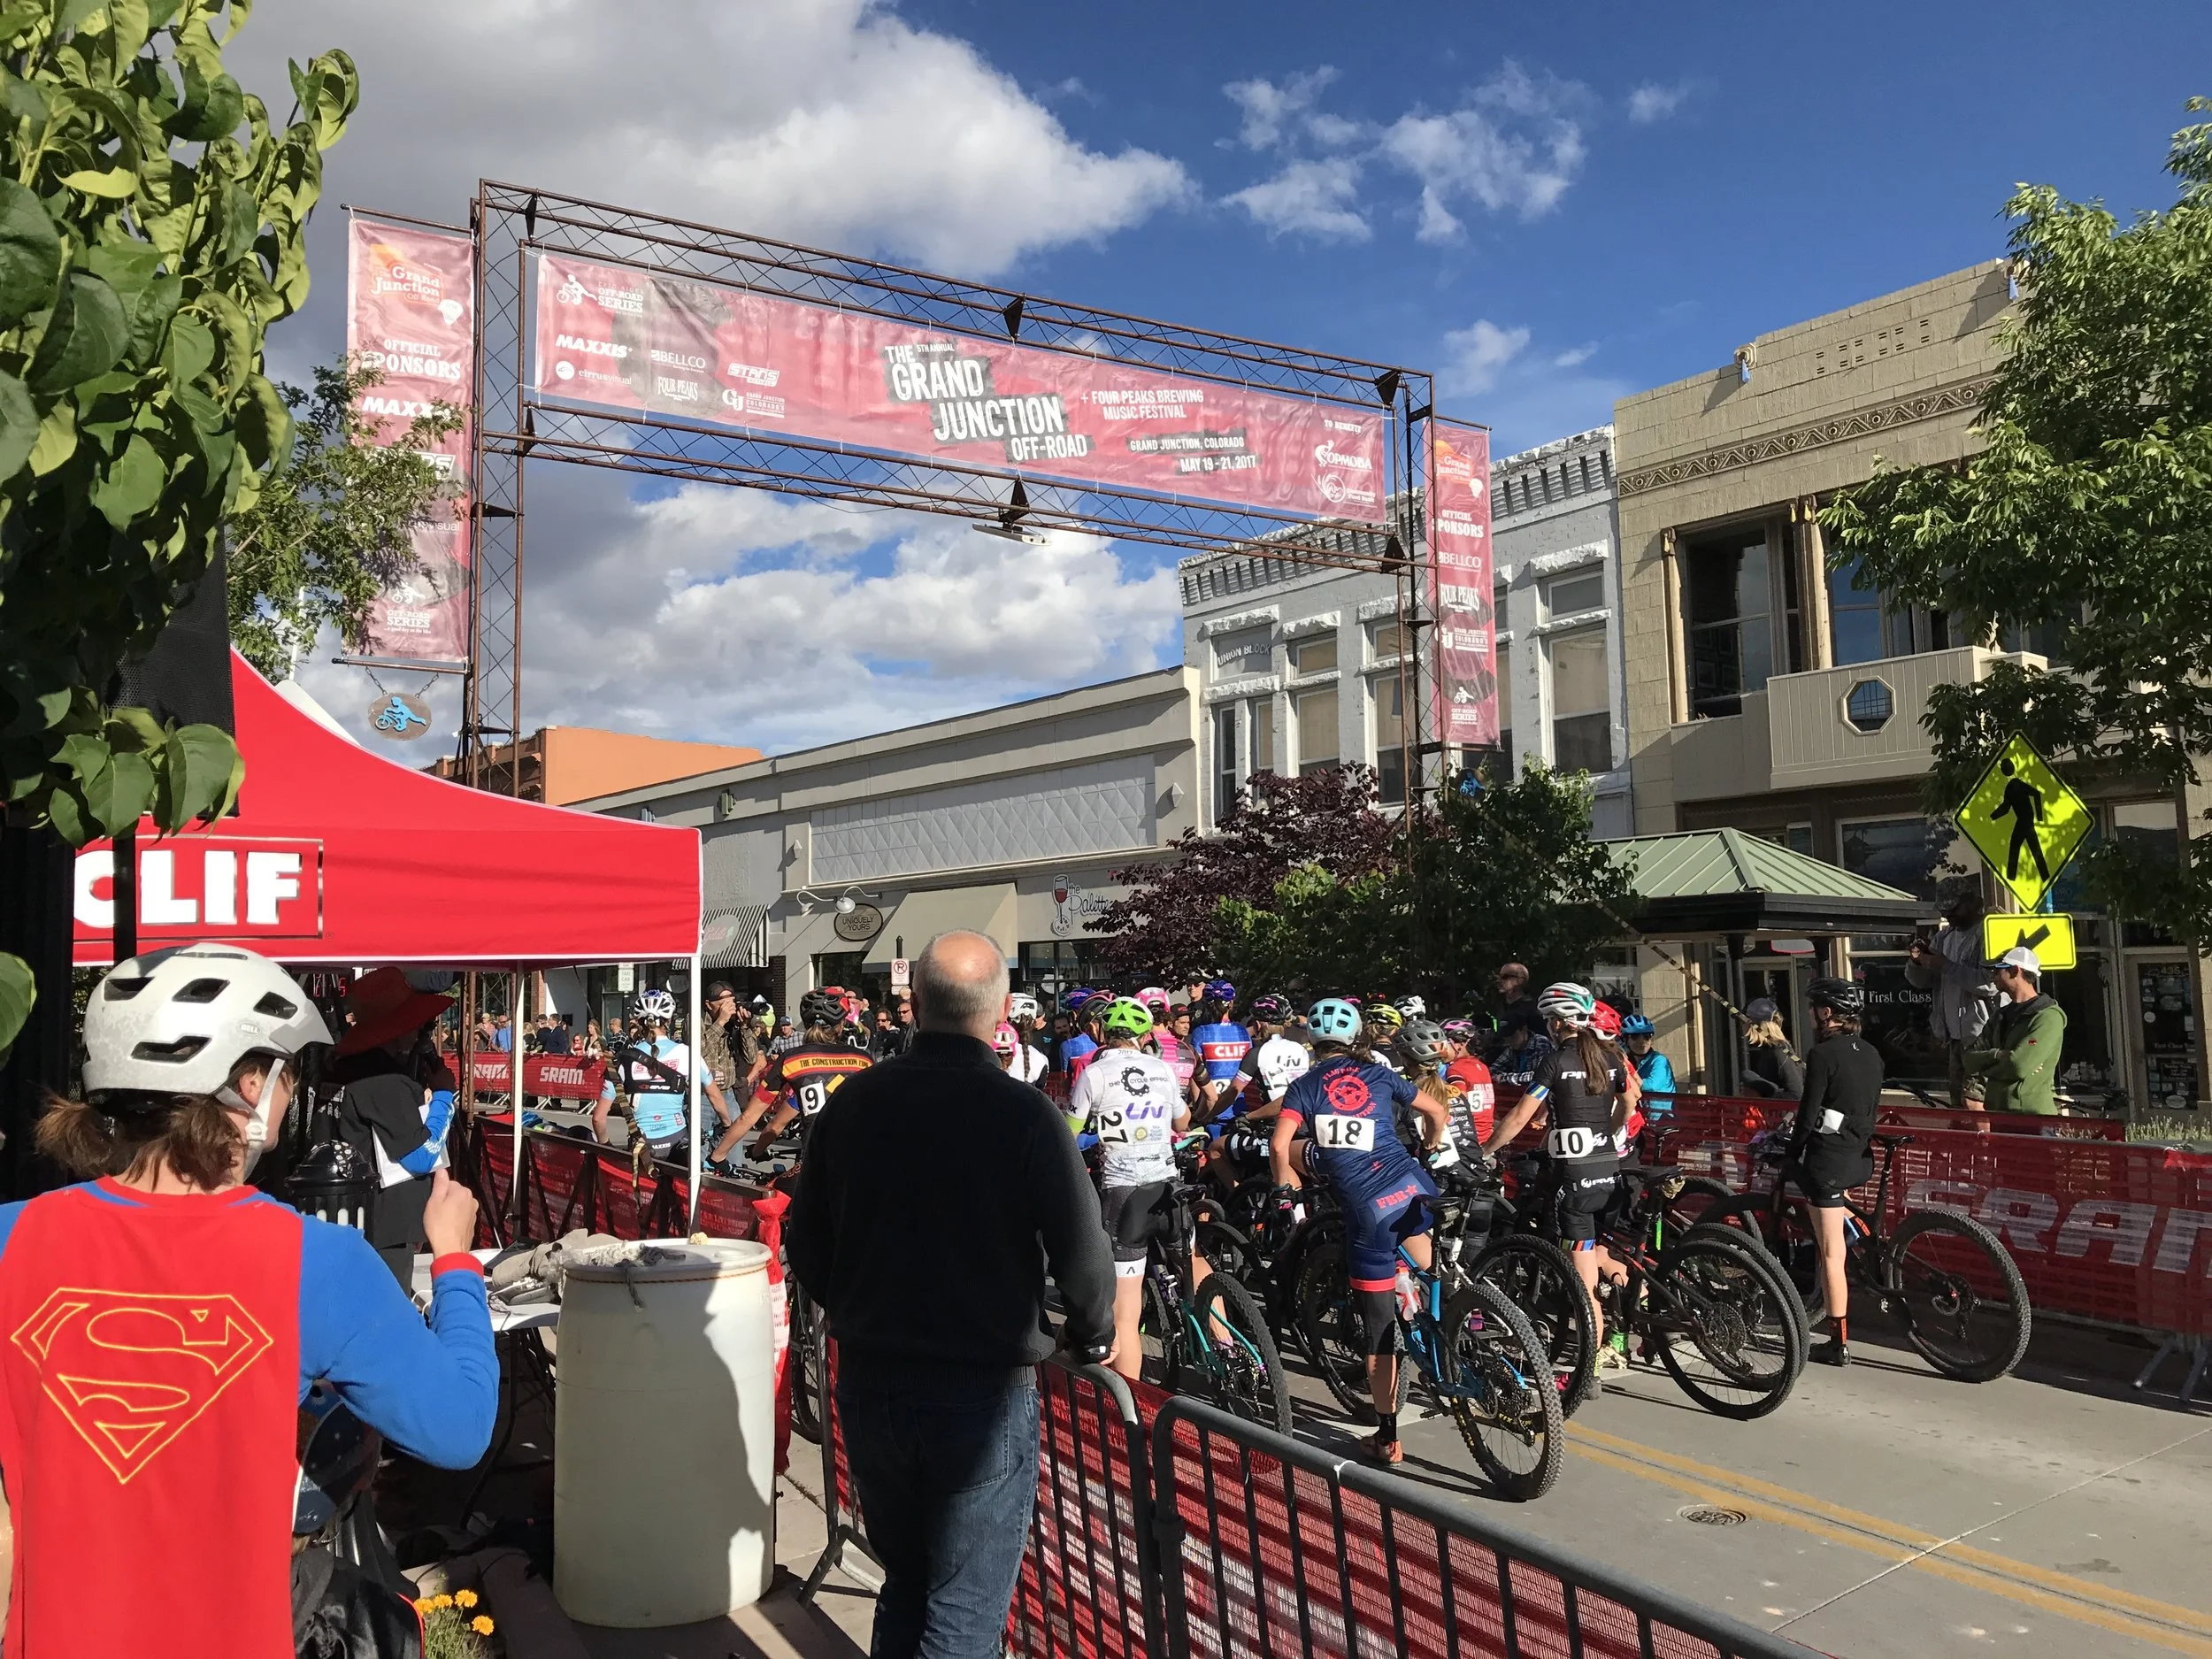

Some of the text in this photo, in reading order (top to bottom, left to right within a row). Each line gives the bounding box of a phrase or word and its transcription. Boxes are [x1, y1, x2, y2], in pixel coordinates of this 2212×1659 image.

[392, 265, 440, 288] Grand
[371, 277, 440, 297] Junction
[598, 288, 644, 302] OFF-ROAD
[598, 296, 643, 312] SERIES
[384, 339, 440, 357] OFFICIAL
[555, 334, 628, 358] MAXXIS
[917, 343, 955, 353] 5TH ANNUAL
[661, 351, 706, 369] BELLCO
[885, 346, 916, 364] THE
[657, 376, 677, 396] FOUR
[677, 379, 698, 402] PEAKS
[892, 359, 985, 402] GRAND
[1092, 391, 1122, 404] FOUR
[1122, 390, 1157, 403] PEAKS
[1158, 389, 1204, 403] BREWING
[933, 396, 1064, 441] JUNCTION
[1103, 404, 1187, 420] MUSIC FESTIVAL
[1324, 419, 1362, 433] TO BENEFIT
[1010, 434, 1088, 461] OFF-ROAD
[1130, 436, 1245, 451] GRAND JUNCTION, COLORADO
[1180, 457, 1202, 472] MAY
[1202, 457, 1214, 471] 19
[1235, 455, 1256, 469] 2017
[1442, 510, 1471, 522] OFFICIAL
[1444, 553, 1481, 567] BELLCO
[1440, 583, 1479, 611] FOUR PEAKS
[387, 617, 430, 628] SERIES
[388, 609, 430, 619] OFF-ROAD
[1217, 643, 1271, 665] UNION BLOCK
[73, 849, 303, 928] CLIF
[1069, 885, 1080, 895] the
[842, 916, 874, 925] UNIQUELY
[1869, 989, 1932, 1003] First Class
[1214, 1045, 1246, 1057] CLIF
[473, 1064, 507, 1079] RAM
[800, 1059, 810, 1068] THE
[540, 1066, 583, 1085] SRAM
[805, 1087, 819, 1110] 9
[1471, 1093, 1481, 1110] 5
[1125, 1101, 1164, 1120] Liv
[1101, 1111, 1128, 1143] 27
[1328, 1118, 1363, 1145] 18
[1555, 1131, 1584, 1156] 10
